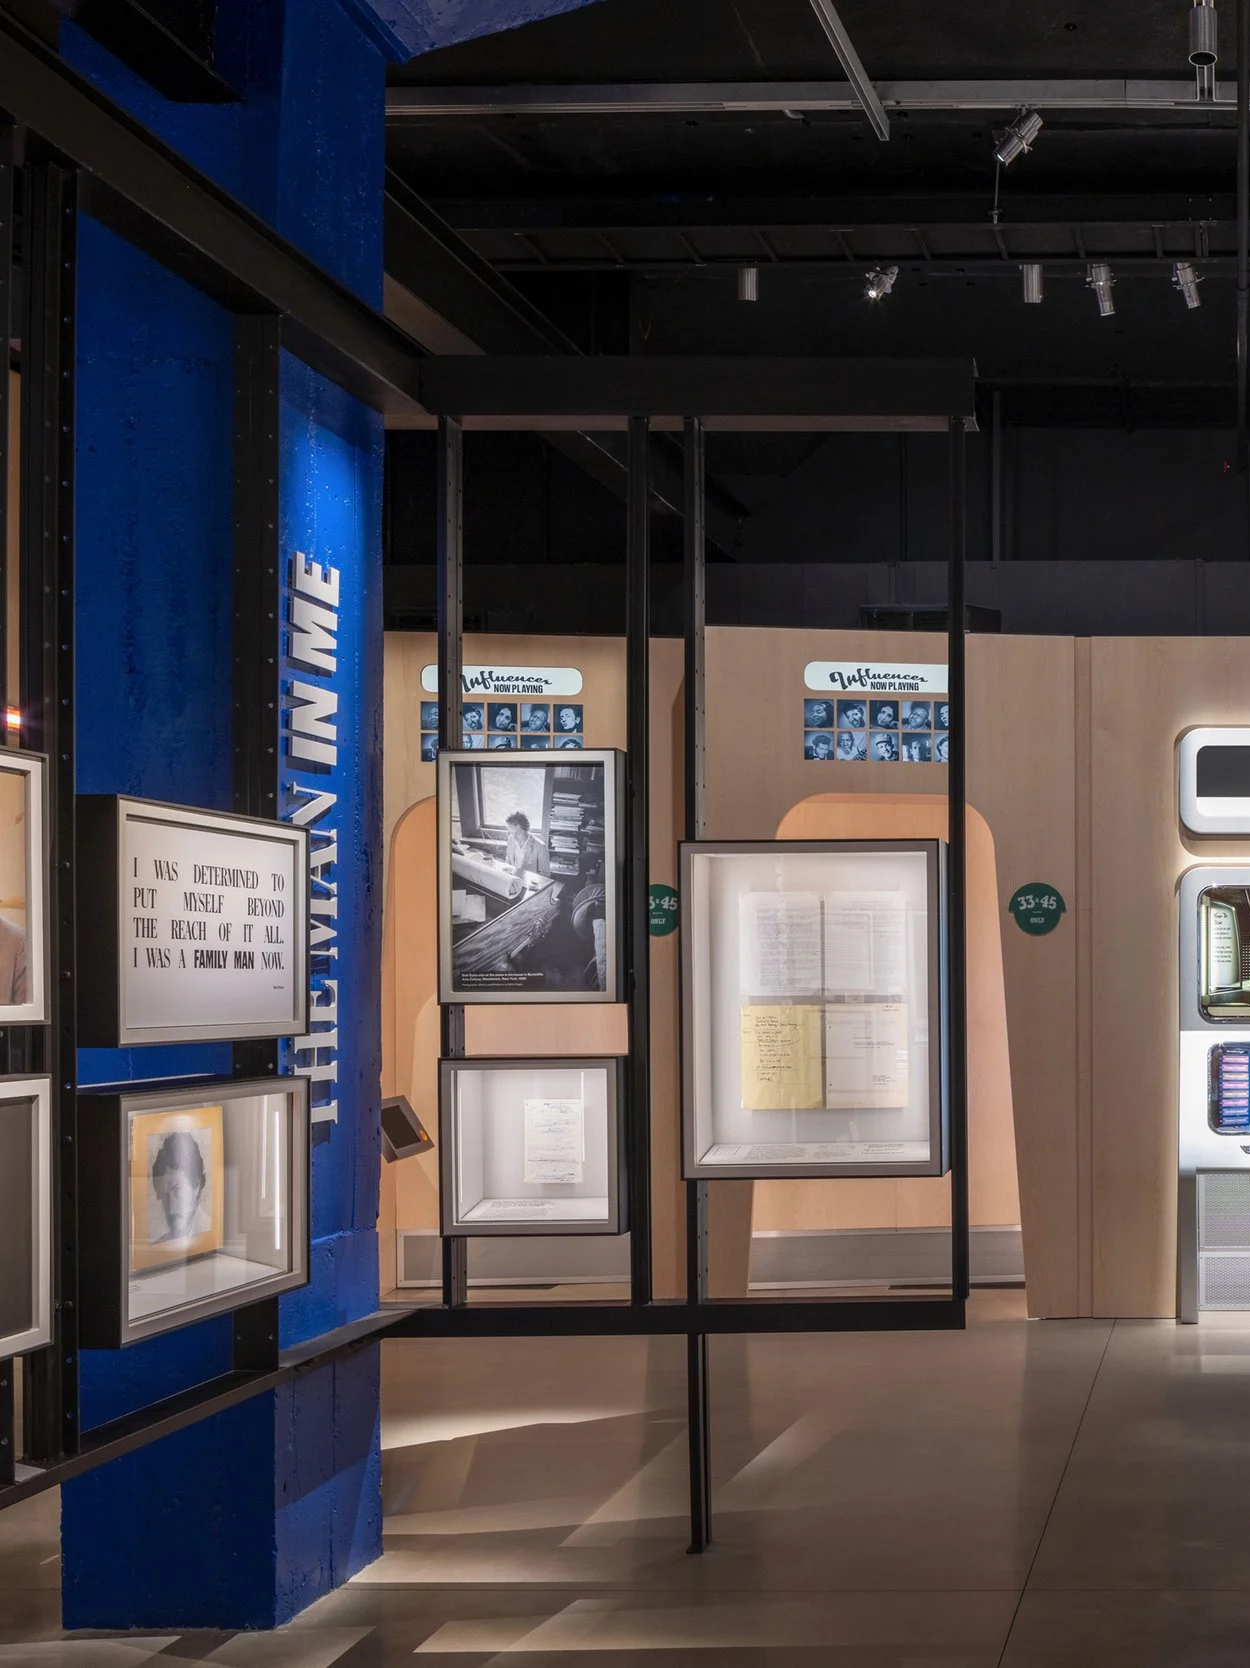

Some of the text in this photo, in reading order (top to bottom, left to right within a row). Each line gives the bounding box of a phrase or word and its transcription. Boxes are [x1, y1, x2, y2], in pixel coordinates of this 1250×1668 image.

[289, 551, 340, 673] ME
[494, 684, 543, 694] NOW PLAYING
[828, 668, 928, 691] Influences
[870, 681, 920, 691] NOW PLAYING
[289, 680, 338, 766] IN
[133, 857, 285, 892] I WAS DETERMINED TO
[133, 887, 285, 918] PUT MYSELF BEYOND
[133, 917, 285, 944] THE REACH OF IT ALL.
[133, 947, 285, 970] I WAS A FAMILY MAN NOW.
